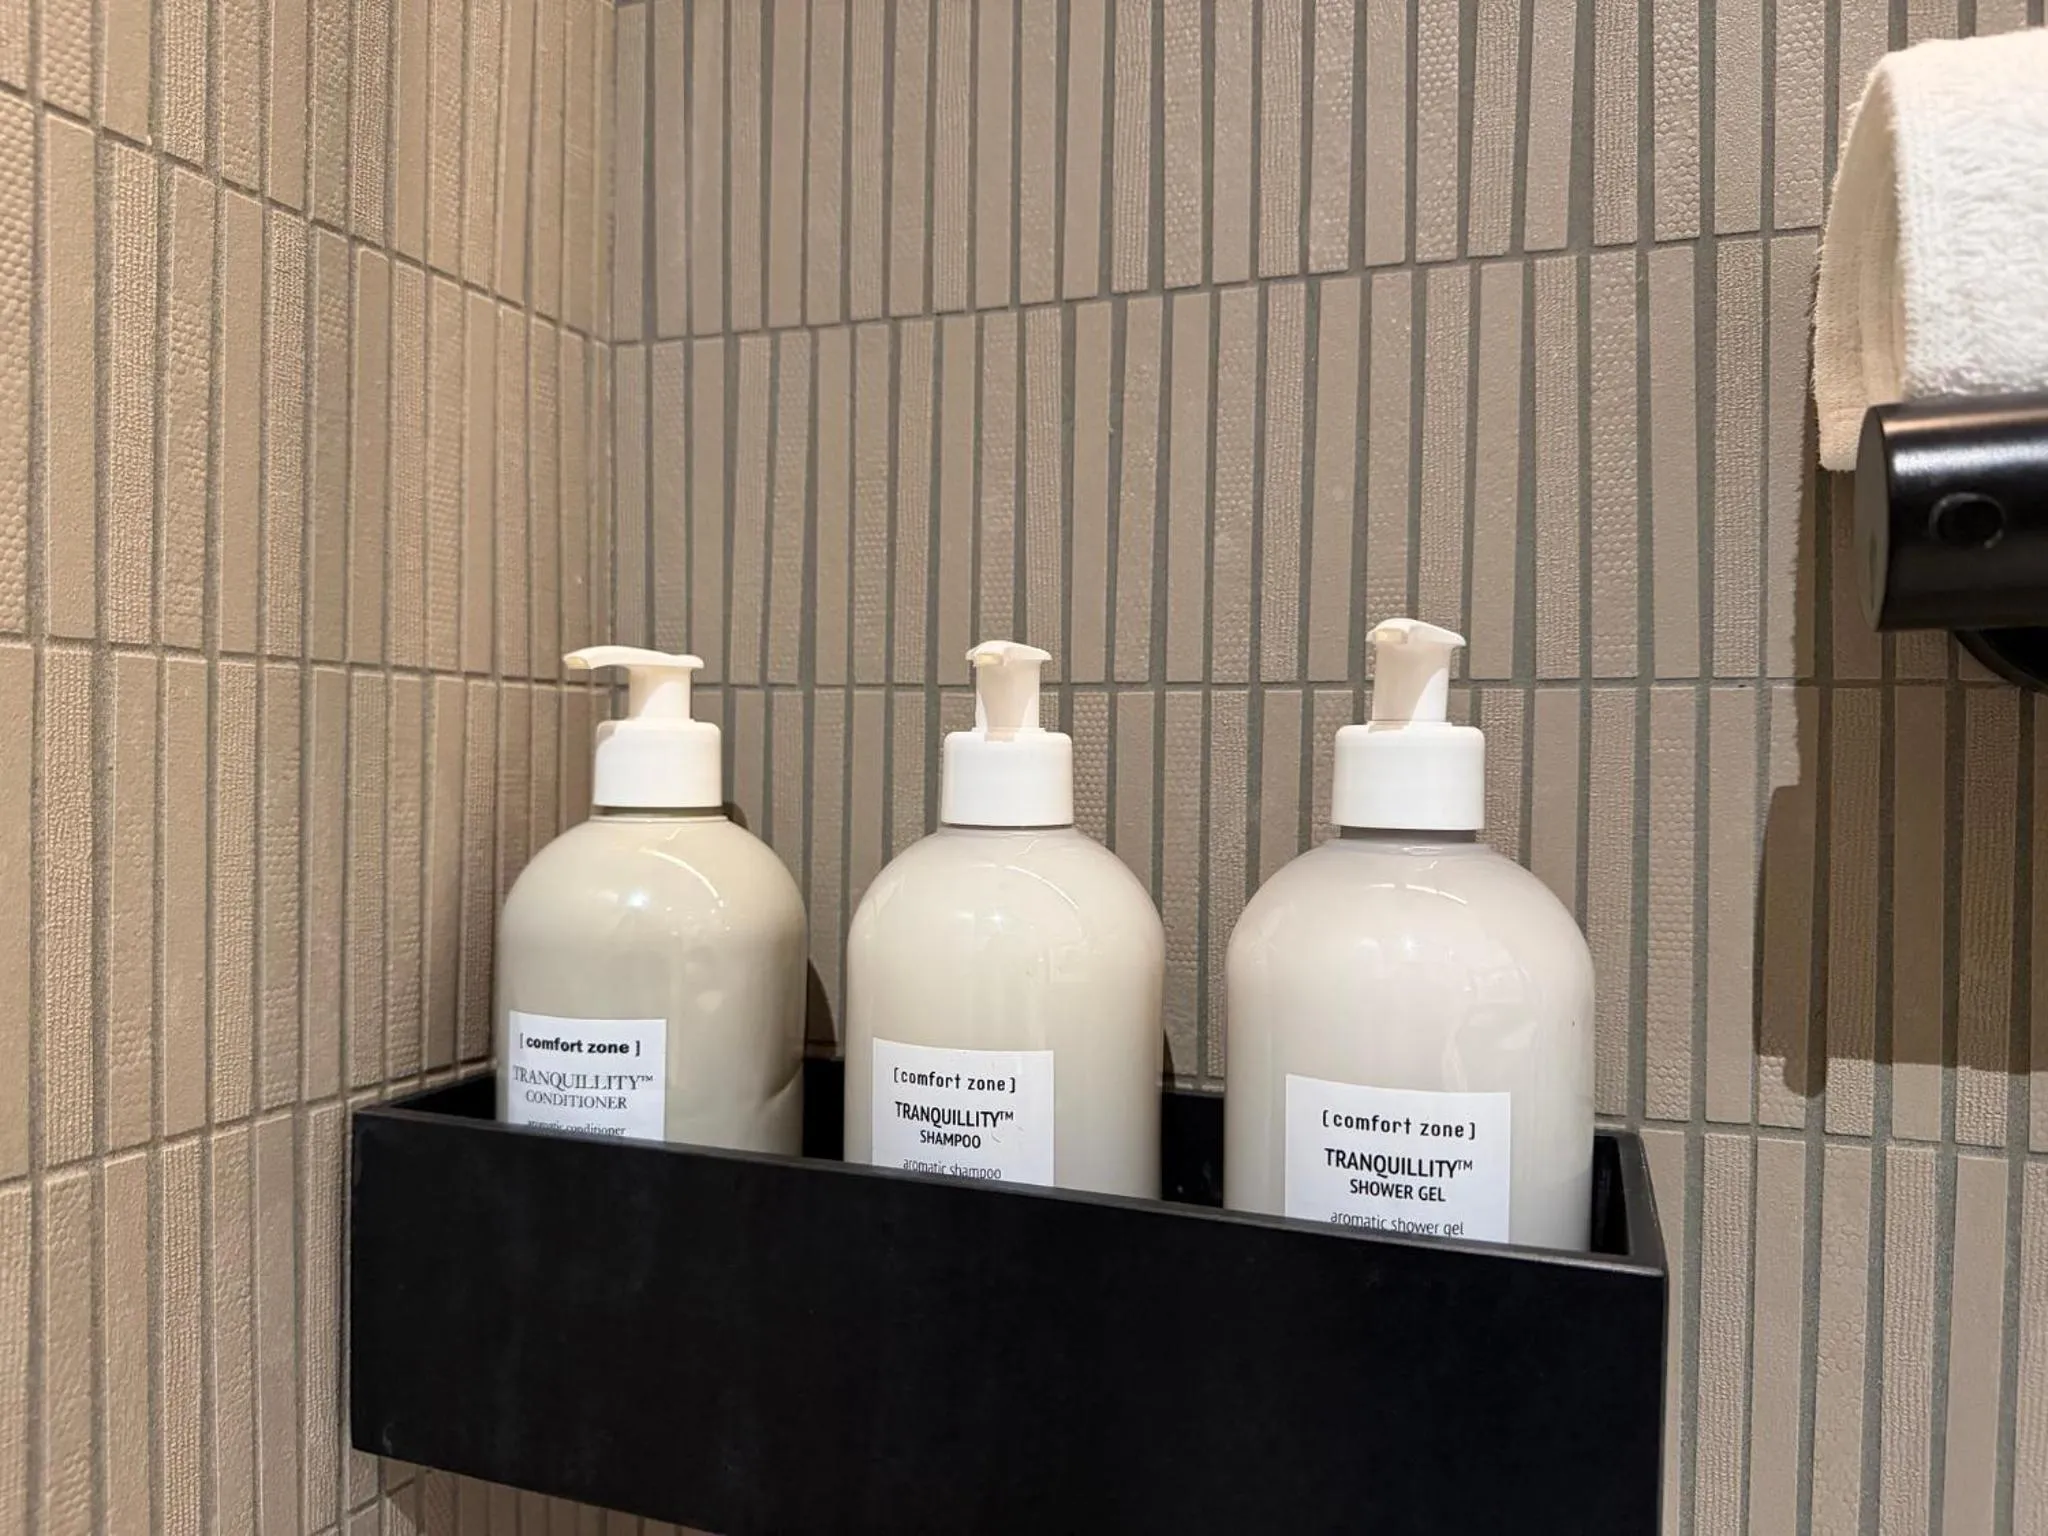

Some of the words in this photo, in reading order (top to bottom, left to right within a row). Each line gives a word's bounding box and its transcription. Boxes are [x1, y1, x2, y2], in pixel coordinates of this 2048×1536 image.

[526, 1089, 628, 1110] CONDITIONER
[920, 1129, 982, 1149] SHAMPOO
[949, 1162, 1002, 1180] shampoo
[1350, 1178, 1414, 1200] SHOWER
[1418, 1186, 1447, 1202] GEL
[1330, 1210, 1388, 1230] aromatic
[1391, 1217, 1439, 1235] shower
[1443, 1220, 1465, 1237] gel
